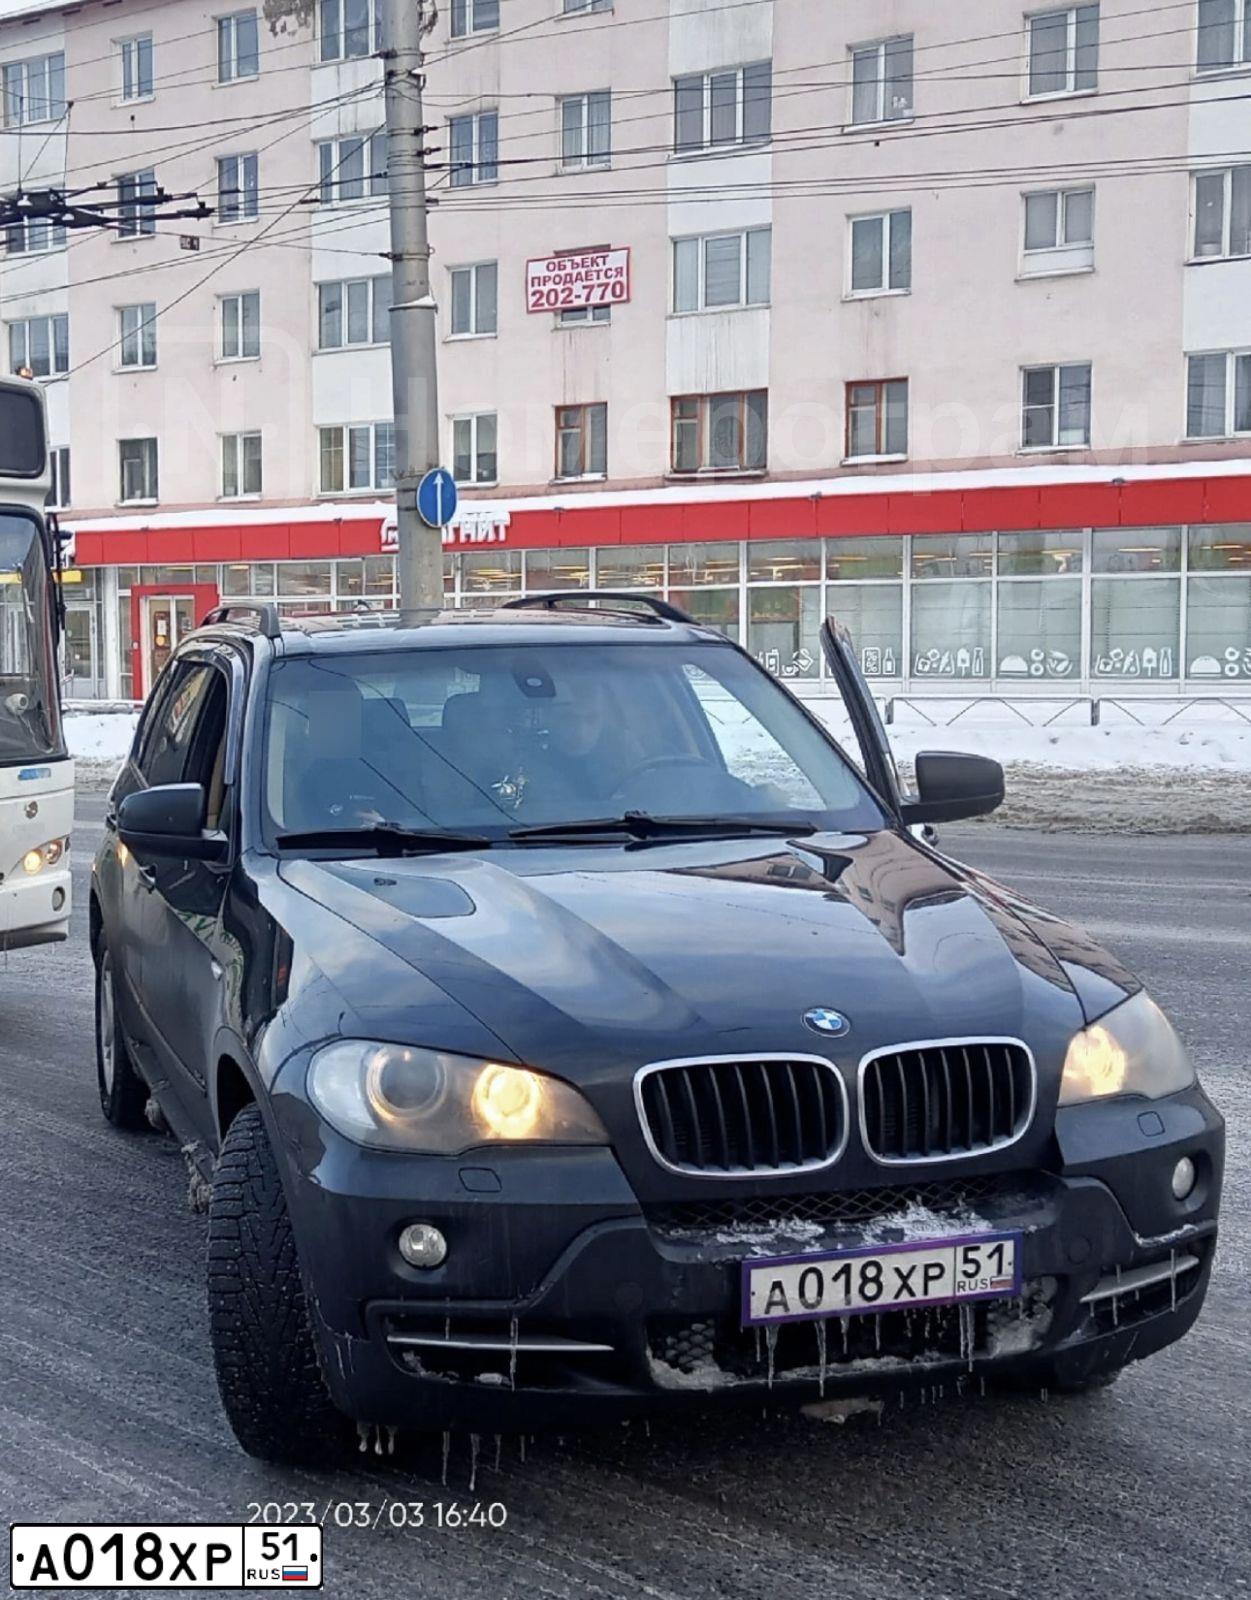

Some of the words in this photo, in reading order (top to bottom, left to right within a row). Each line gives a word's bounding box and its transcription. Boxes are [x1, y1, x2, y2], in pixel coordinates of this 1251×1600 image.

[546, 255, 609, 272] ОБЪЕКТ
[531, 281, 624, 308] 202-770
[764, 1260, 946, 1314] А018ХР
[961, 1242, 1005, 1279] 51
[957, 1277, 989, 1292] RUS
